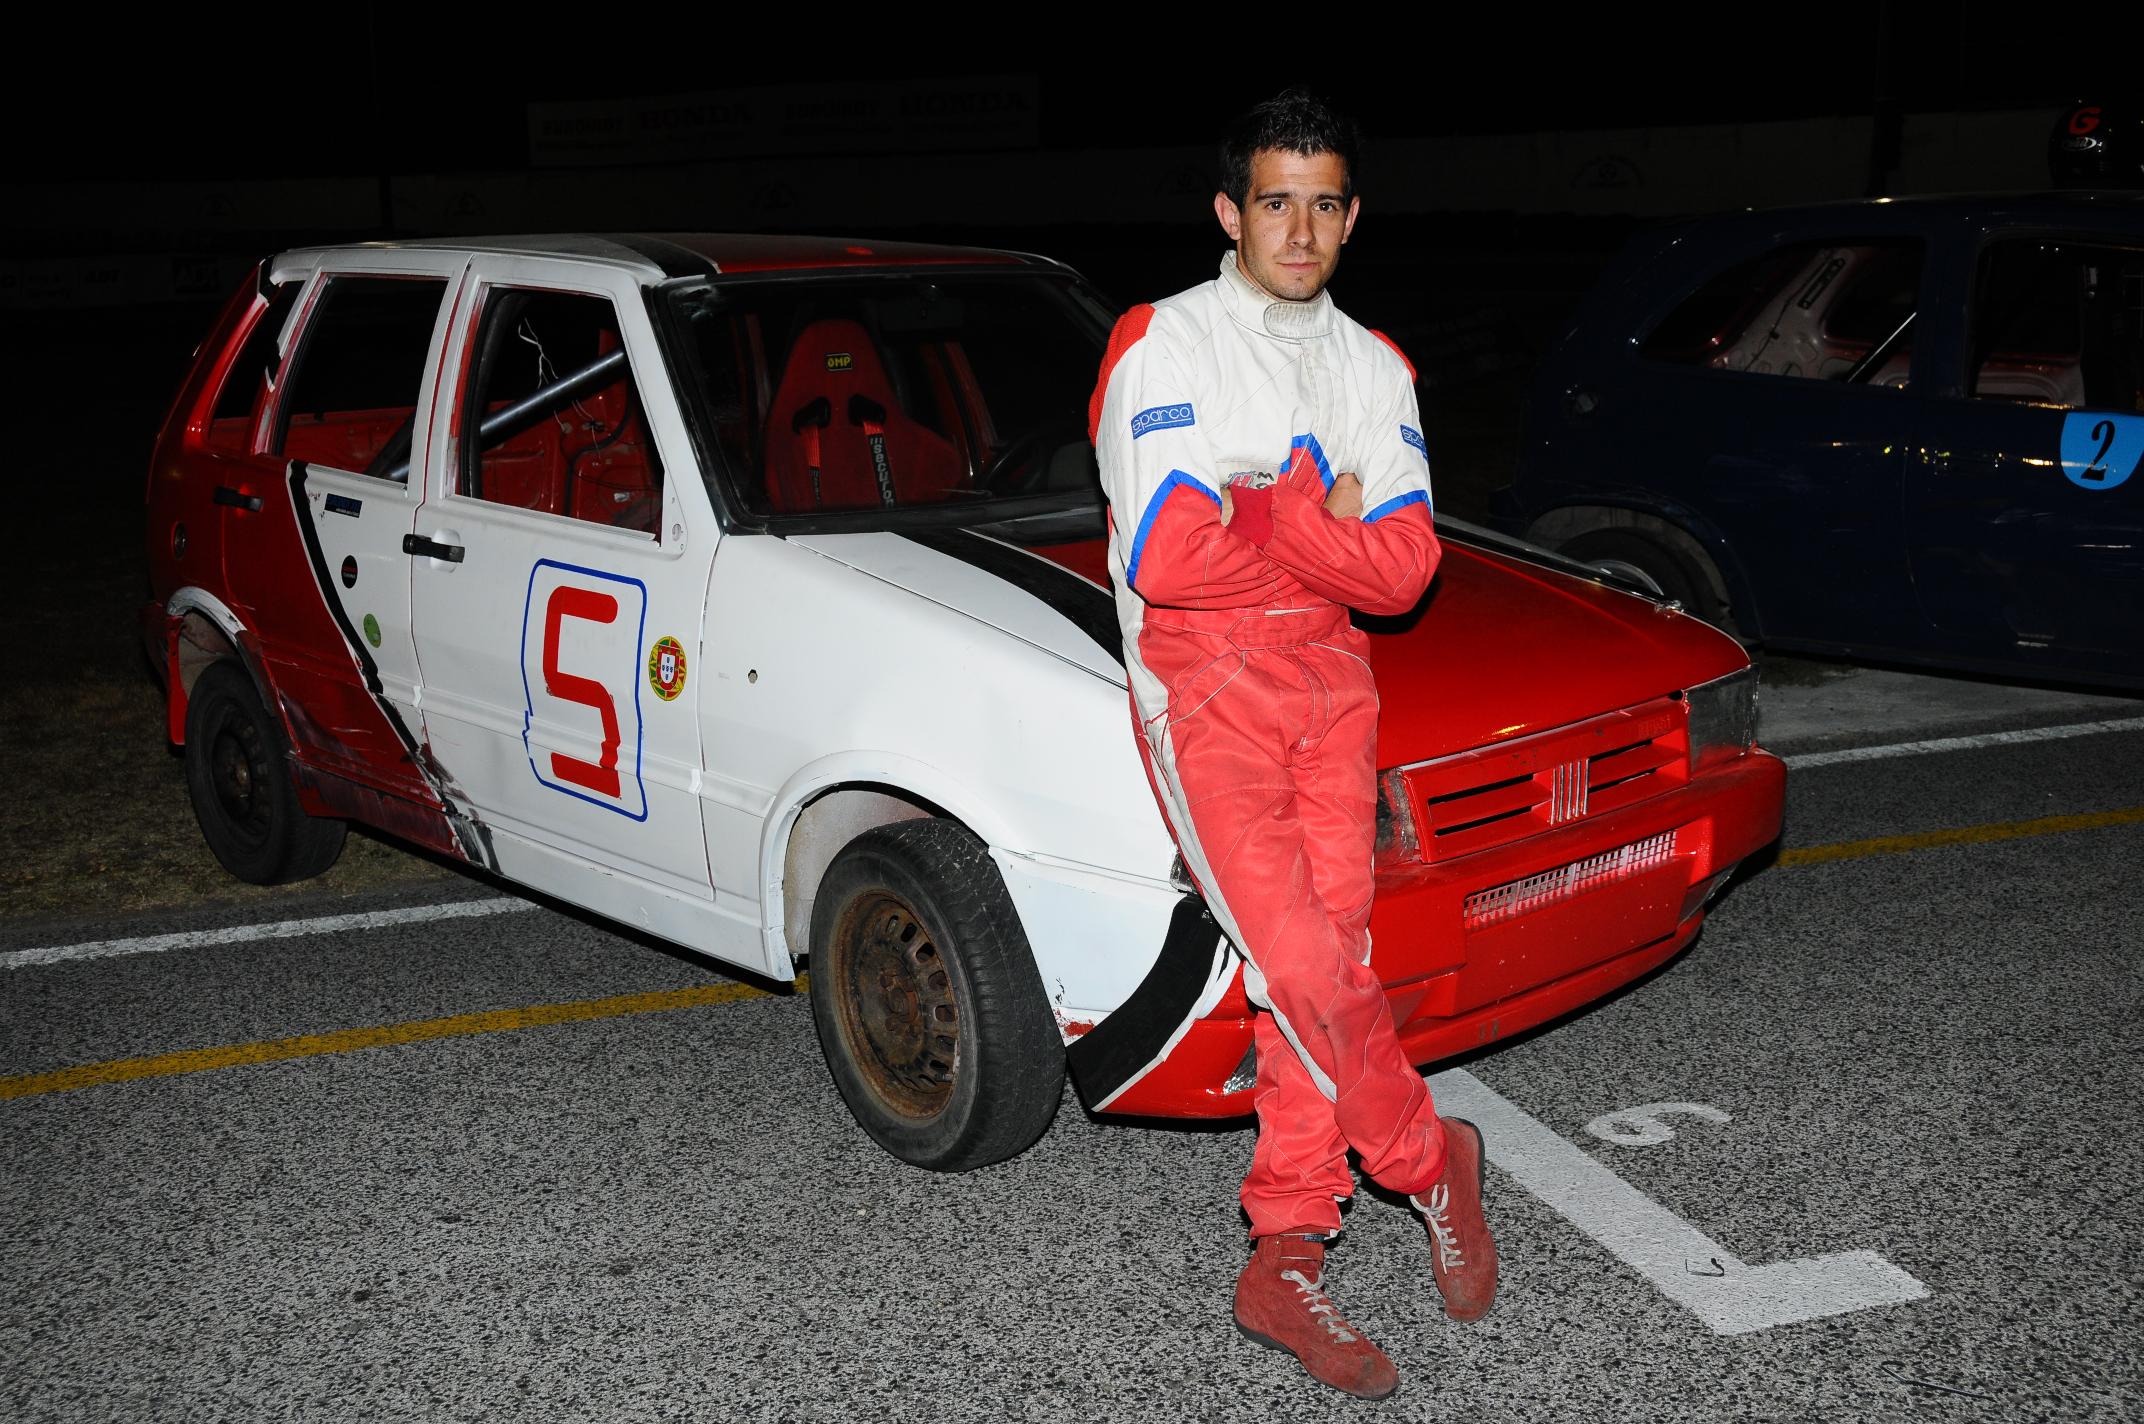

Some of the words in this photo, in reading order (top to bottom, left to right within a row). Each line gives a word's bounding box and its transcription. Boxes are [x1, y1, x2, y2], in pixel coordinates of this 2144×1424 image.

[2069, 106, 2102, 136] G
[827, 356, 851, 368] OMP
[1133, 406, 1191, 431] sparco
[2081, 420, 2116, 481] 2
